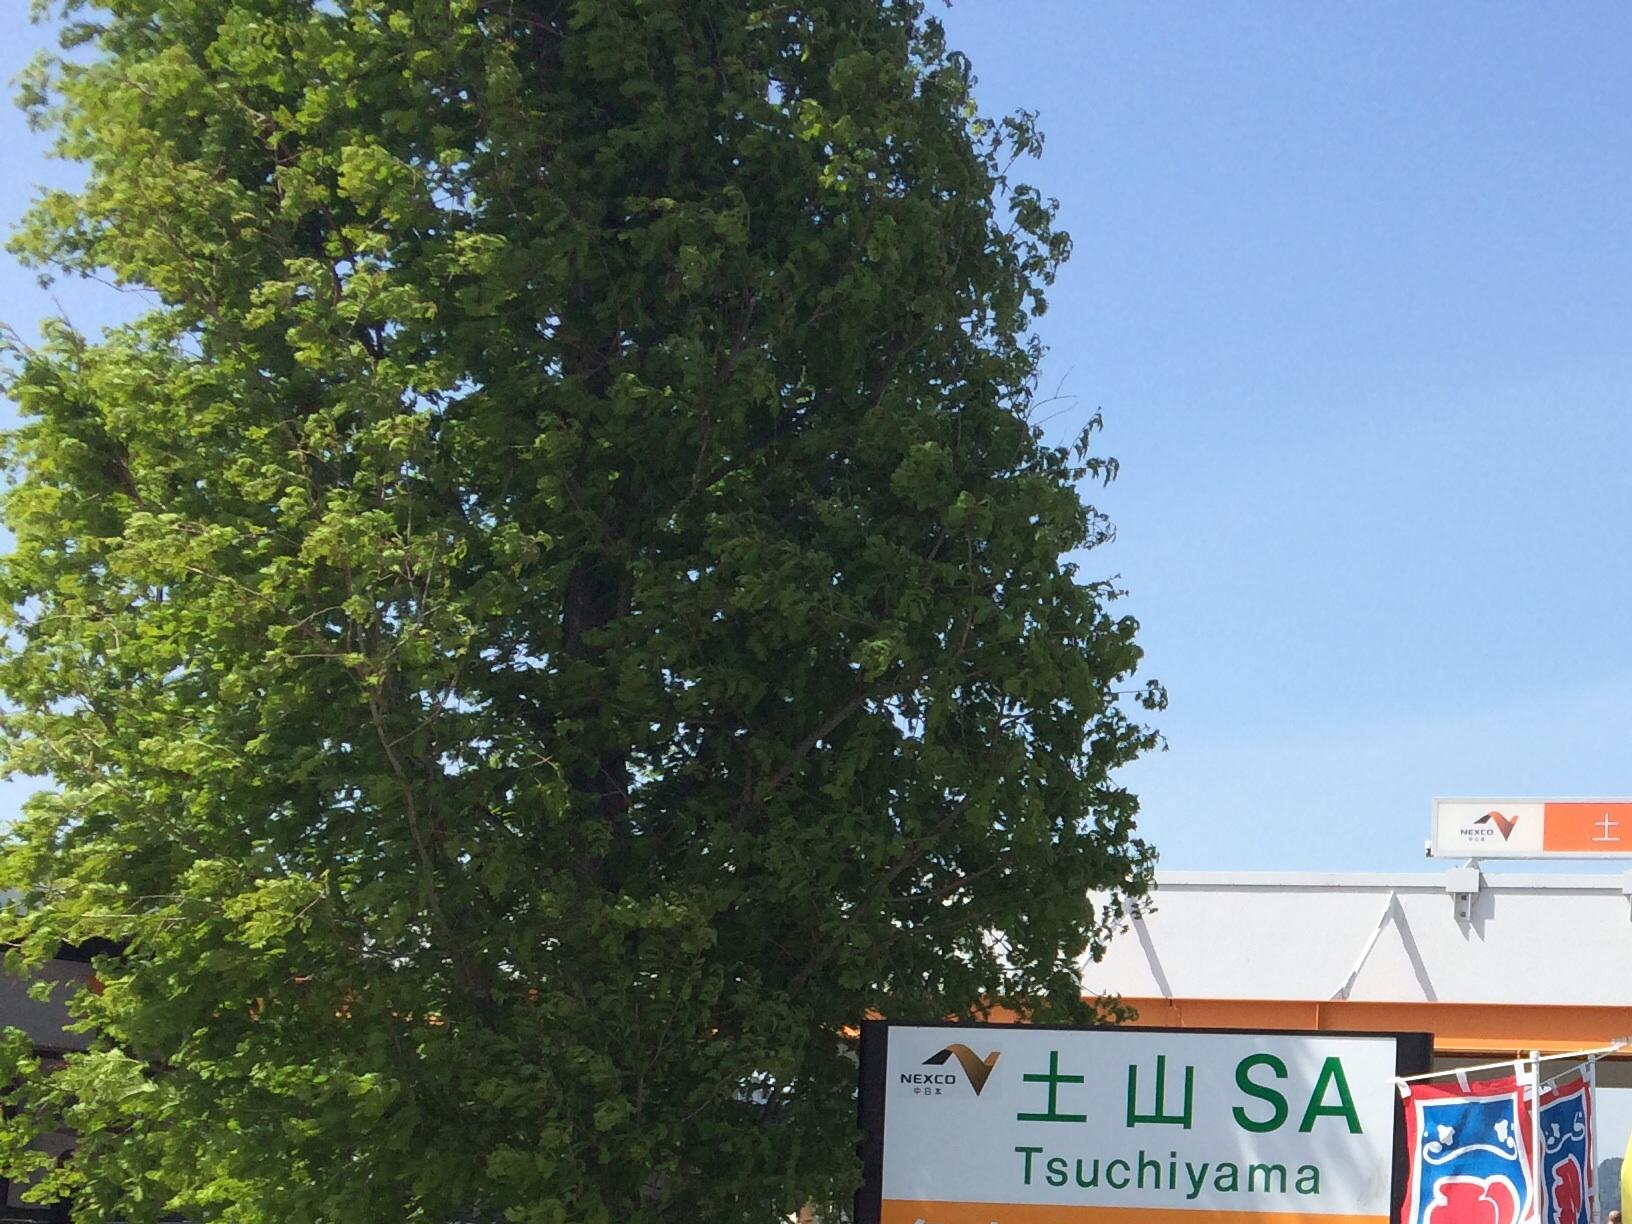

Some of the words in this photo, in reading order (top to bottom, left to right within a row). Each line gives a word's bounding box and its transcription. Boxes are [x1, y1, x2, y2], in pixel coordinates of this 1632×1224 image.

[900, 1073, 956, 1085] NEXCO
[1231, 1052, 1364, 1135] SA
[1014, 1146, 1322, 1200] Tsuchiyama
